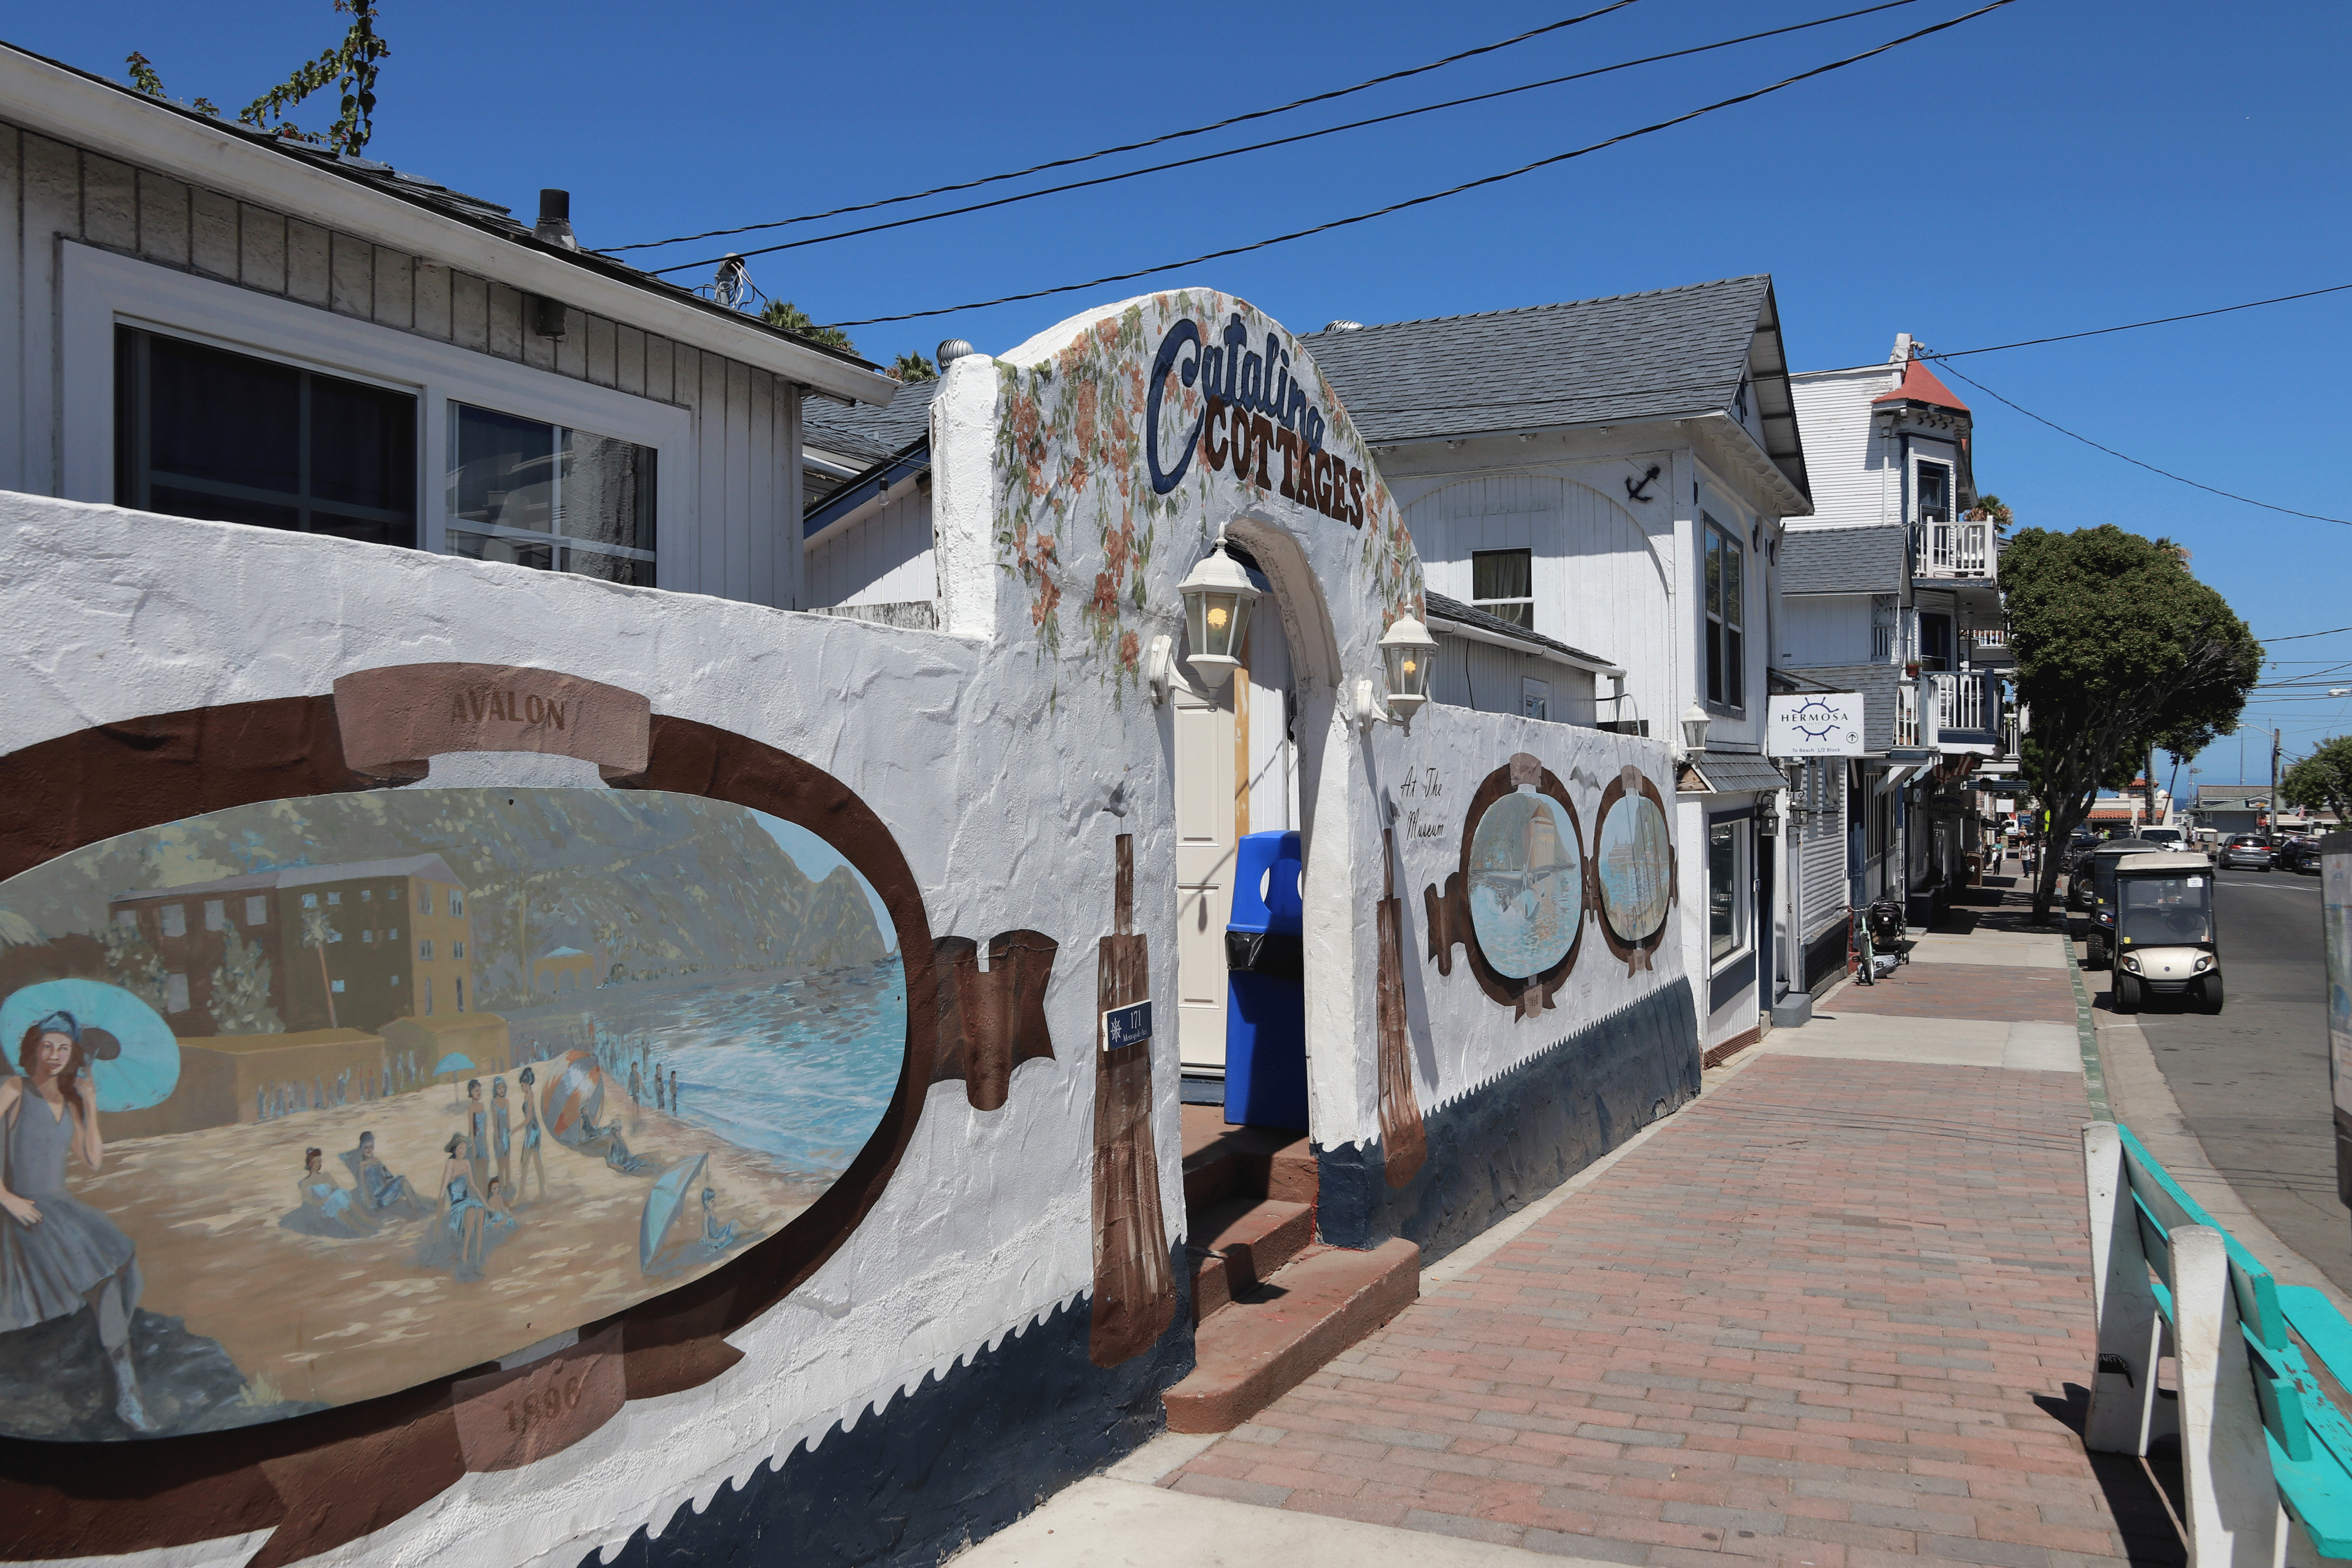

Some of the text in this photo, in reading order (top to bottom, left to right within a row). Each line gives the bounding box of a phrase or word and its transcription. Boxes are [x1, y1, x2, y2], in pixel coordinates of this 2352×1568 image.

[1147, 313, 1325, 494] Catalina
[1204, 394, 1366, 530] COTTAGES
[450, 690, 566, 731] AVALON
[1781, 713, 1849, 722] HERMOSA
[1401, 765, 1442, 797] At The
[1406, 808, 1444, 841] Museum
[1130, 1009, 1141, 1029] 171
